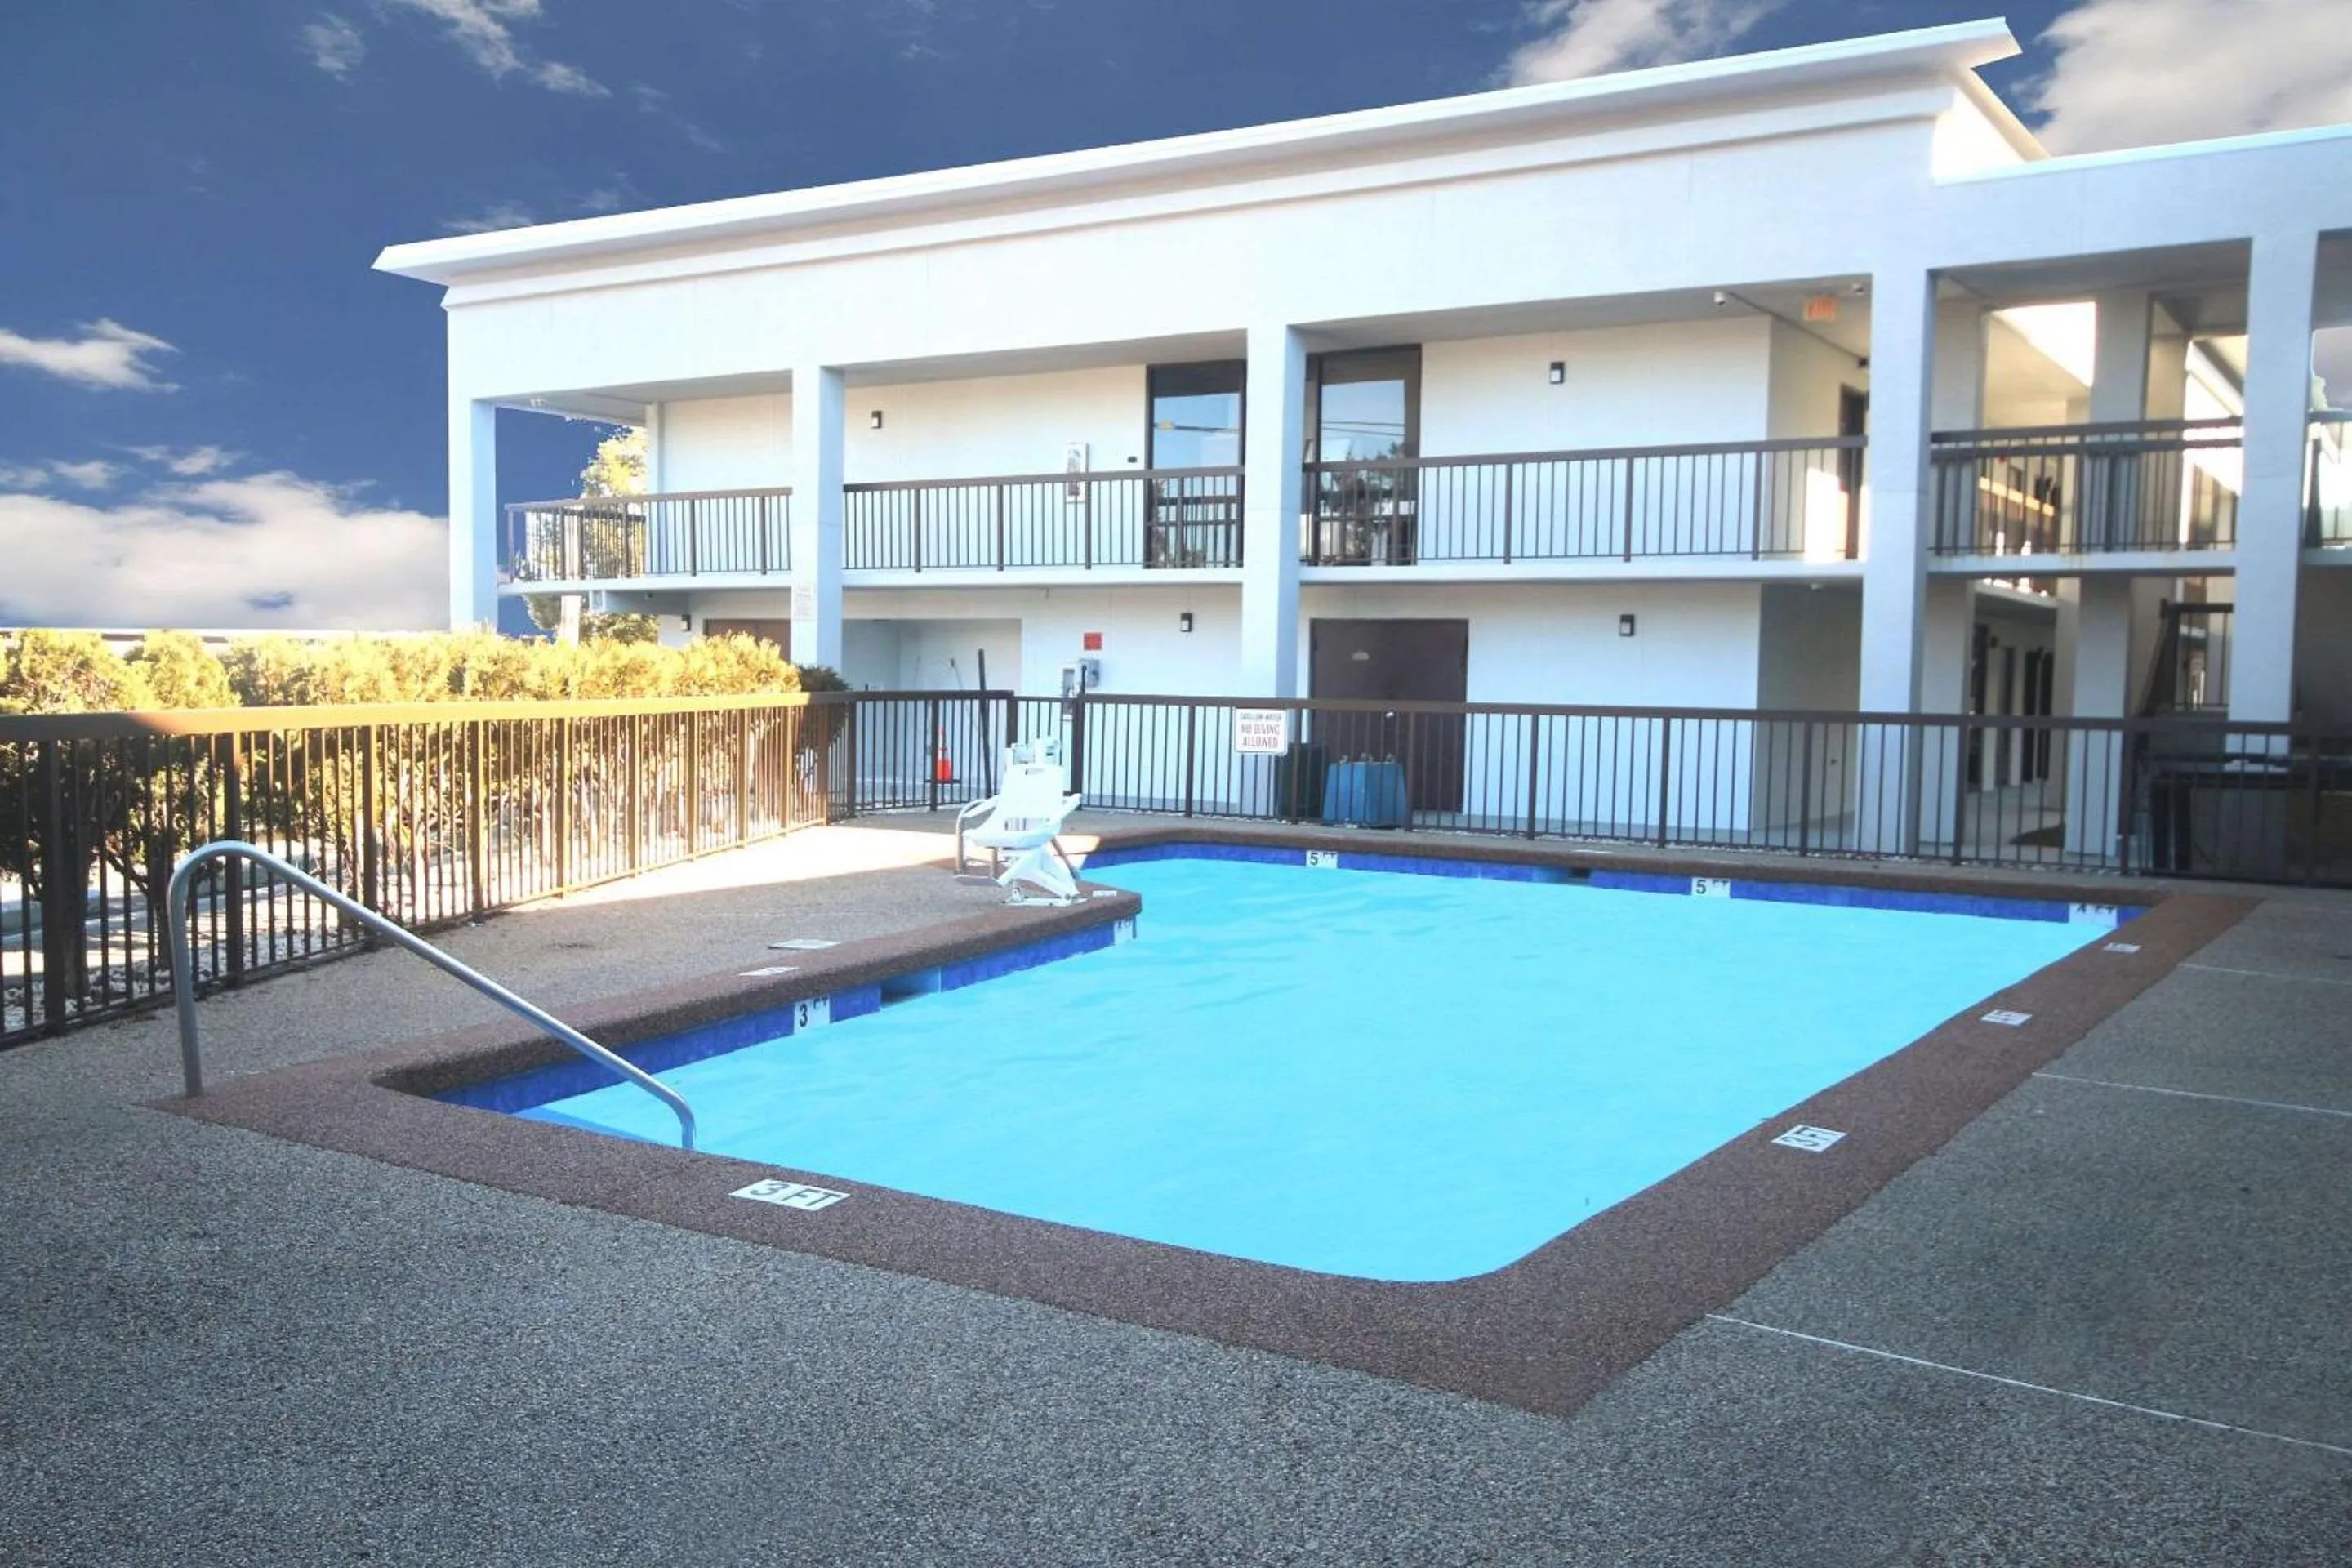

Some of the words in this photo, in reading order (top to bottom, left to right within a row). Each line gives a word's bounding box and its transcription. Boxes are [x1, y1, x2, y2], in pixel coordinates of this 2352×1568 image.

[1241, 724, 1252, 733] NO
[1254, 724, 1280, 735] DIVING
[1242, 736, 1278, 748] ALLOWED
[1310, 852, 1318, 866] 5
[1696, 879, 1707, 895] 5
[799, 1003, 808, 1027] 3
[750, 1183, 791, 1196] 3
[780, 1188, 843, 1207] FT
